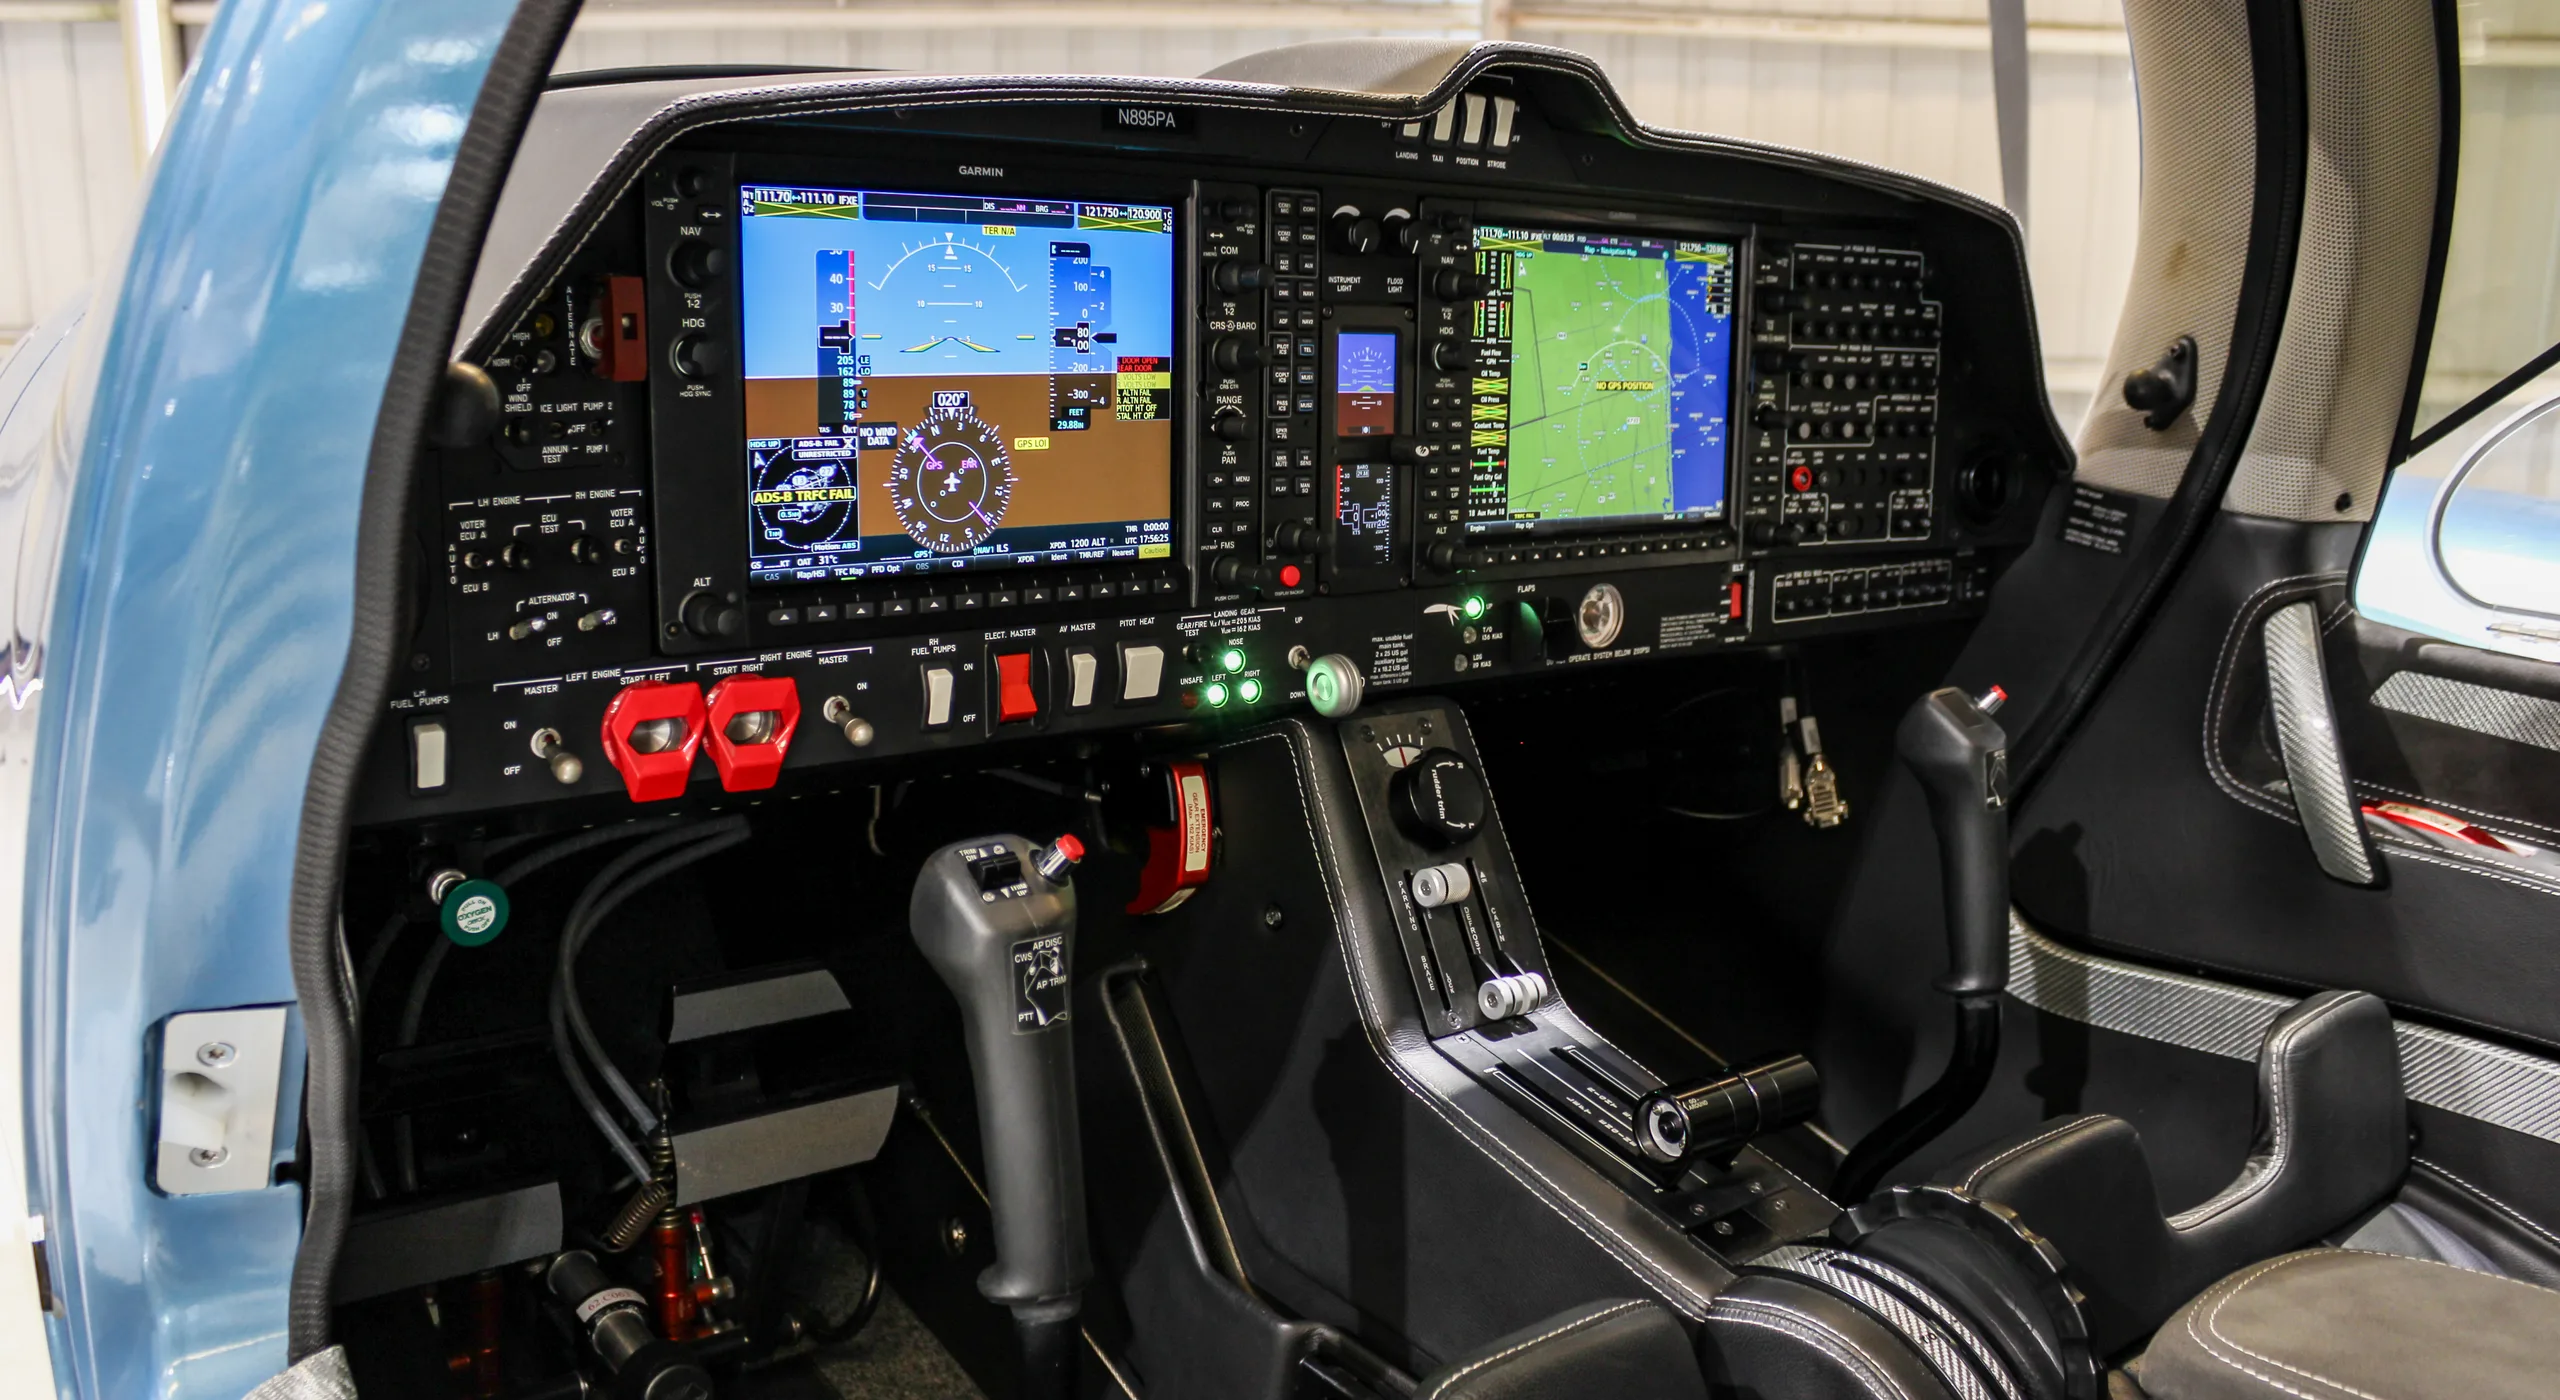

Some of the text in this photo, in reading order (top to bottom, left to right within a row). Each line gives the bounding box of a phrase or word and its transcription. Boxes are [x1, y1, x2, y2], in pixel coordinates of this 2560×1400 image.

[1119, 108, 1176, 128] N895PA
[1456, 156, 1479, 166] POSITION
[958, 165, 1004, 177] GARMIN
[1035, 205, 1049, 213] BRG
[1085, 206, 1162, 220] 121.750 120.900
[680, 226, 702, 237] NAV
[983, 226, 1016, 236] TER N/A
[1220, 246, 1239, 255] COM
[1441, 256, 1455, 265] NAV
[829, 273, 844, 284] 40
[686, 300, 701, 309] 1-2
[830, 302, 844, 313] 30
[1224, 307, 1235, 316] 1-2
[682, 318, 705, 328] HDG
[1210, 321, 1257, 330] CRS BARO
[1439, 327, 1454, 335] HDG
[512, 332, 531, 341] HIGH
[837, 355, 854, 365] 205
[516, 383, 532, 392] OFF
[1596, 381, 1654, 391] NO GPS POSITION
[508, 394, 528, 403] WIND
[1216, 396, 1242, 404] RANGE
[504, 403, 533, 412] SHIELD
[540, 403, 578, 413] ICE LIGHT
[583, 402, 613, 411] PUMP 2
[1068, 408, 1084, 416] FEET
[859, 426, 897, 436] NO WIND
[867, 437, 890, 446] DATA
[541, 445, 569, 454] ANNUN
[798, 450, 852, 458] UNRESTRICTED
[542, 455, 562, 463] TEST
[1221, 456, 1237, 465] PAN
[575, 489, 616, 500] RH ENGINE
[753, 488, 855, 504] ADS-B TRFC FAIL
[477, 496, 521, 507] LH ENGINE
[610, 508, 634, 518] VOTER
[541, 514, 557, 523] ECU
[610, 518, 635, 528] ECU A
[460, 520, 486, 530] VOTER
[540, 524, 560, 534] TEST
[1469, 524, 1486, 533] Engine
[1435, 526, 1448, 535] ALT
[460, 531, 488, 541] ECU A
[1124, 534, 1169, 544] UTC 17:56:25
[996, 543, 1009, 553] ILS
[1049, 537, 1106, 550] XPDR 1200 ALT
[1220, 541, 1236, 549] FMS
[1112, 549, 1135, 558] Nearest
[1143, 546, 1167, 555] Caution
[1017, 555, 1035, 564] XPDR
[1050, 552, 1068, 562] Ident
[448, 543, 458, 585] AUTO
[915, 562, 930, 571] OBS
[951, 560, 965, 568] CDI
[612, 566, 637, 577] ECU B
[834, 567, 864, 578] TFC Map
[871, 564, 901, 575] PFD Opt
[693, 577, 712, 588] ALT
[764, 573, 780, 582] CAS
[462, 582, 490, 593] ECU B
[1517, 584, 1537, 594] FLAPS
[528, 592, 576, 606] ALTERNATOR
[546, 611, 559, 620] ON
[1213, 607, 1256, 619] LANDING GEAR
[1119, 616, 1156, 628] PITOT HEAT
[1176, 620, 1208, 630] GEAR/FIRE
[1294, 616, 1304, 624] UP
[1059, 622, 1096, 634] AV MASTER
[1185, 629, 1200, 637] TEST
[487, 632, 500, 641] LH
[984, 628, 1037, 641] ELECT. MASTER
[546, 636, 563, 647] OFF
[929, 638, 939, 647] RH
[1228, 638, 1244, 646] NOSE
[911, 644, 957, 656] FUEL PUMPS
[760, 650, 813, 663] RIGHT ENGINE
[818, 655, 849, 666] MASTER
[1568, 653, 1591, 663] OPERATE
[1593, 650, 1613, 660] SYSTEM
[713, 663, 764, 676] START RIGHT
[963, 663, 974, 671] ON
[566, 668, 621, 682] LEFT ENGINE
[1211, 673, 1227, 682] LEFT
[1244, 669, 1261, 678] RIGHT
[1180, 675, 1204, 686] UNSAFE
[524, 684, 559, 696] MASTER
[857, 682, 868, 691] ON
[1289, 690, 1306, 699] DOWN
[390, 695, 450, 709] FUEL PUMPS
[962, 714, 976, 723] OFF
[503, 720, 518, 730] ON
[503, 765, 521, 776] OFF
[1431, 768, 1446, 820] rudder trim
[1192, 792, 1200, 812] GEAR
[1397, 880, 1418, 932] PARKING
[457, 905, 493, 922] OXYGEN
[1490, 907, 1506, 942] CABIN
[1463, 906, 1482, 955] DEFROST
[1032, 936, 1063, 951] AP DISC
[1014, 952, 1033, 964] CWS
[1420, 955, 1436, 991] BRAKE
[1036, 974, 1068, 991] AP TRIM
[1018, 1012, 1035, 1022] PTT
